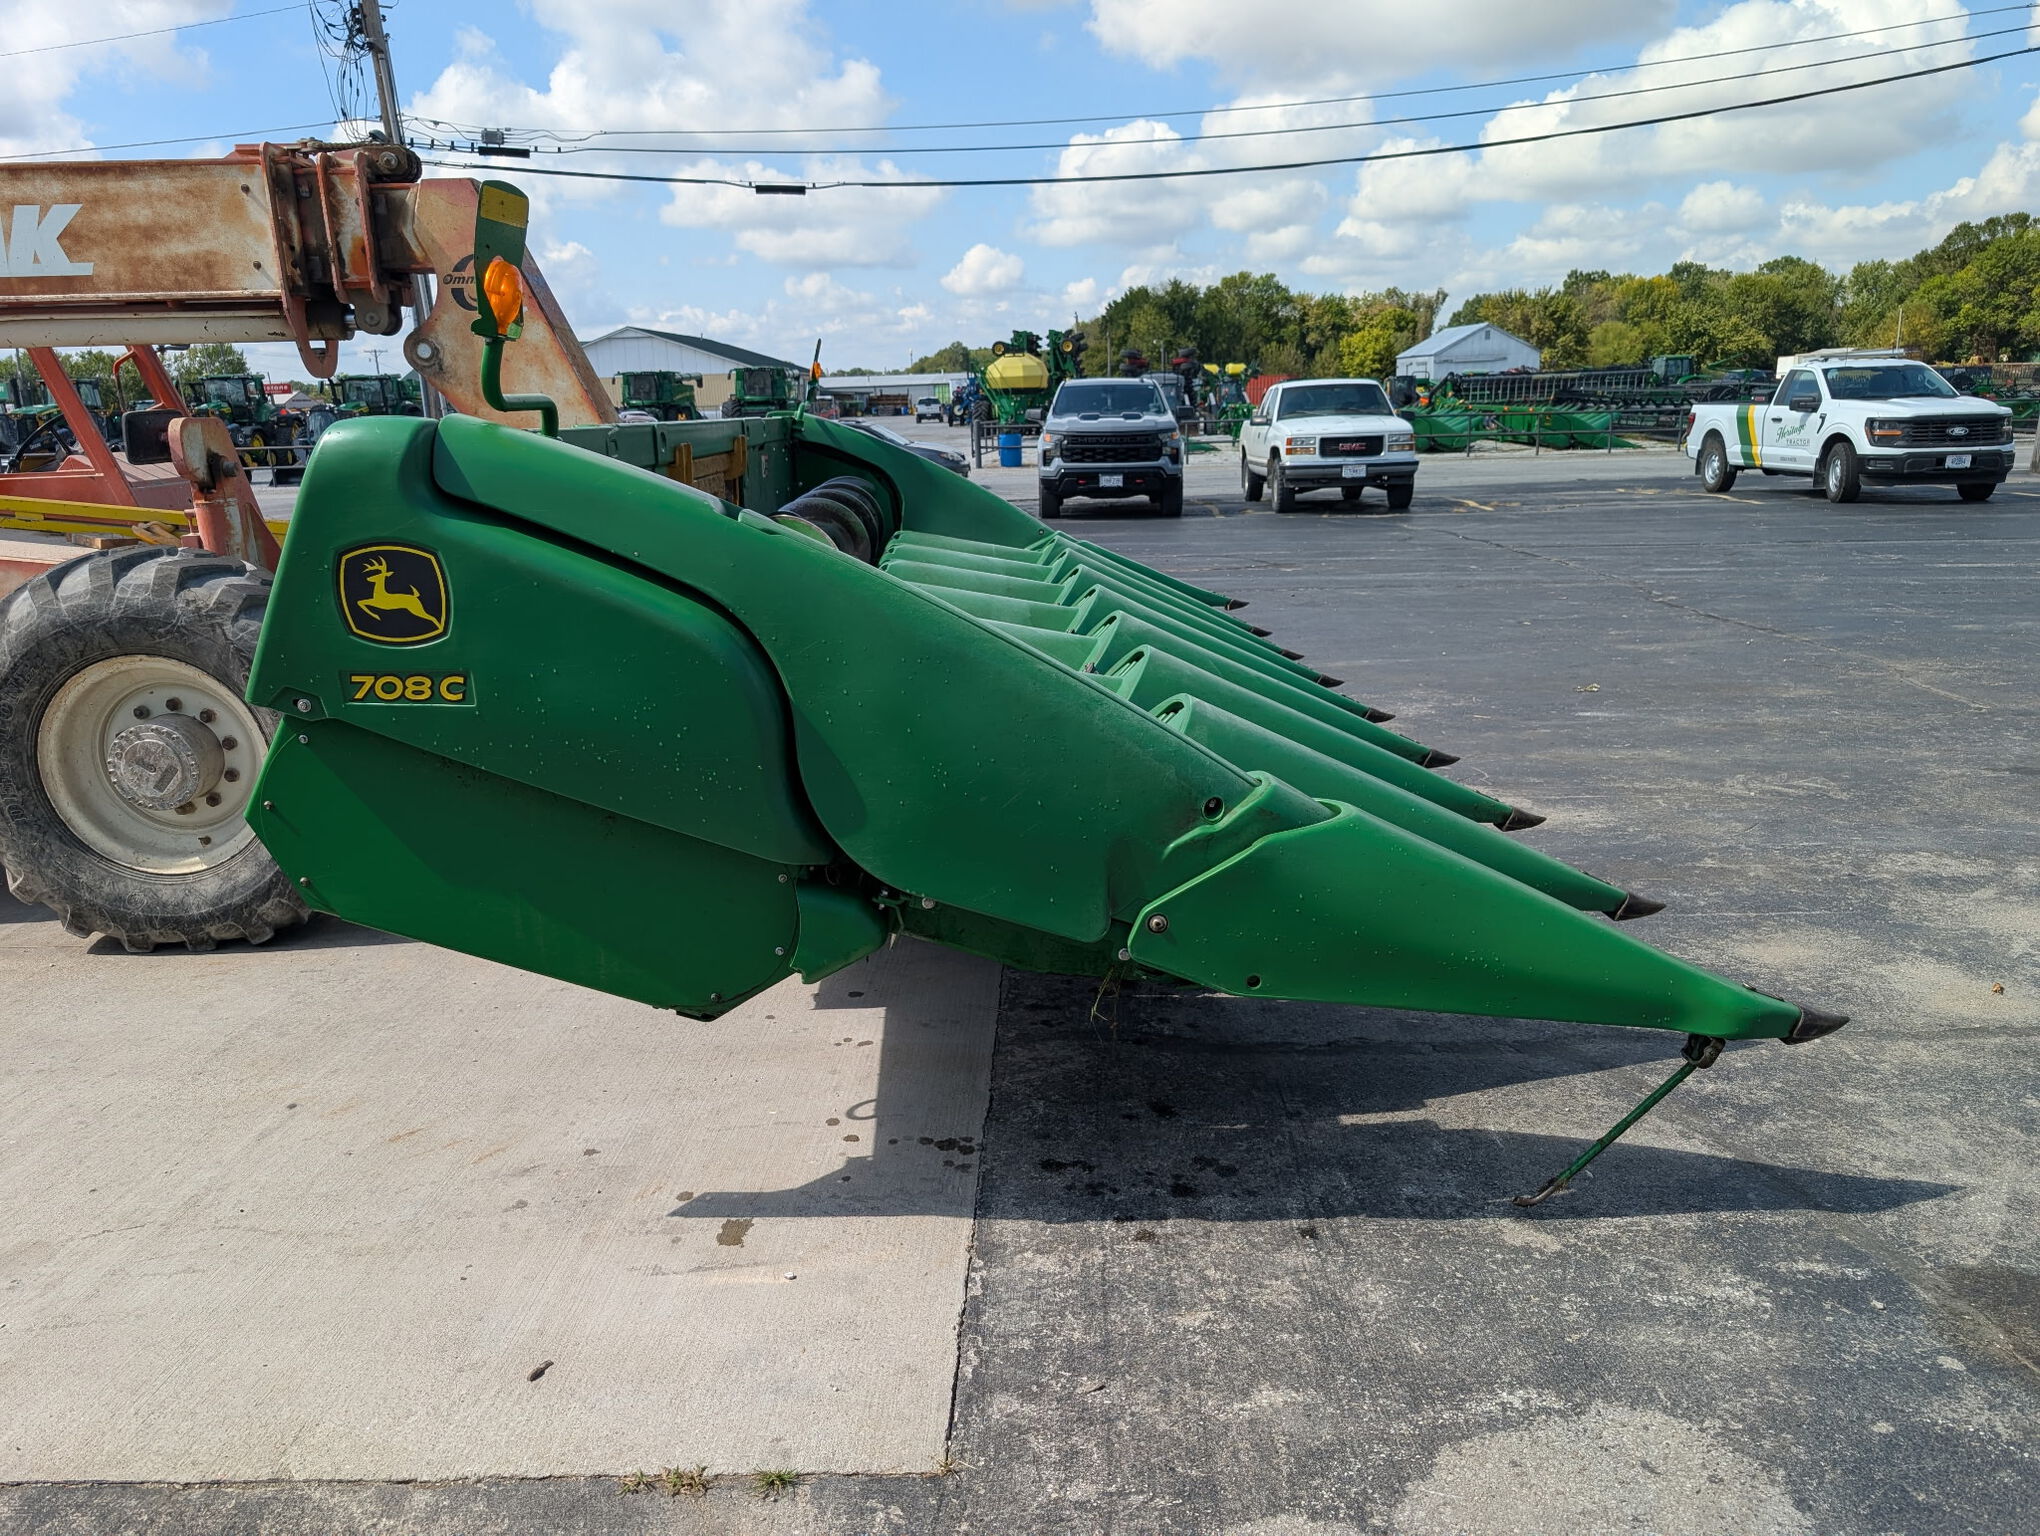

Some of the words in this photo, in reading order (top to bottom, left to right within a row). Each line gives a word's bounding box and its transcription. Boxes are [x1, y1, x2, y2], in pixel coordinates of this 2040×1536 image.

[0, 203, 94, 277] K
[443, 274, 476, 285] Omn
[1776, 424, 1806, 443] Heritage
[351, 675, 432, 700] 708
[439, 675, 465, 701] C
